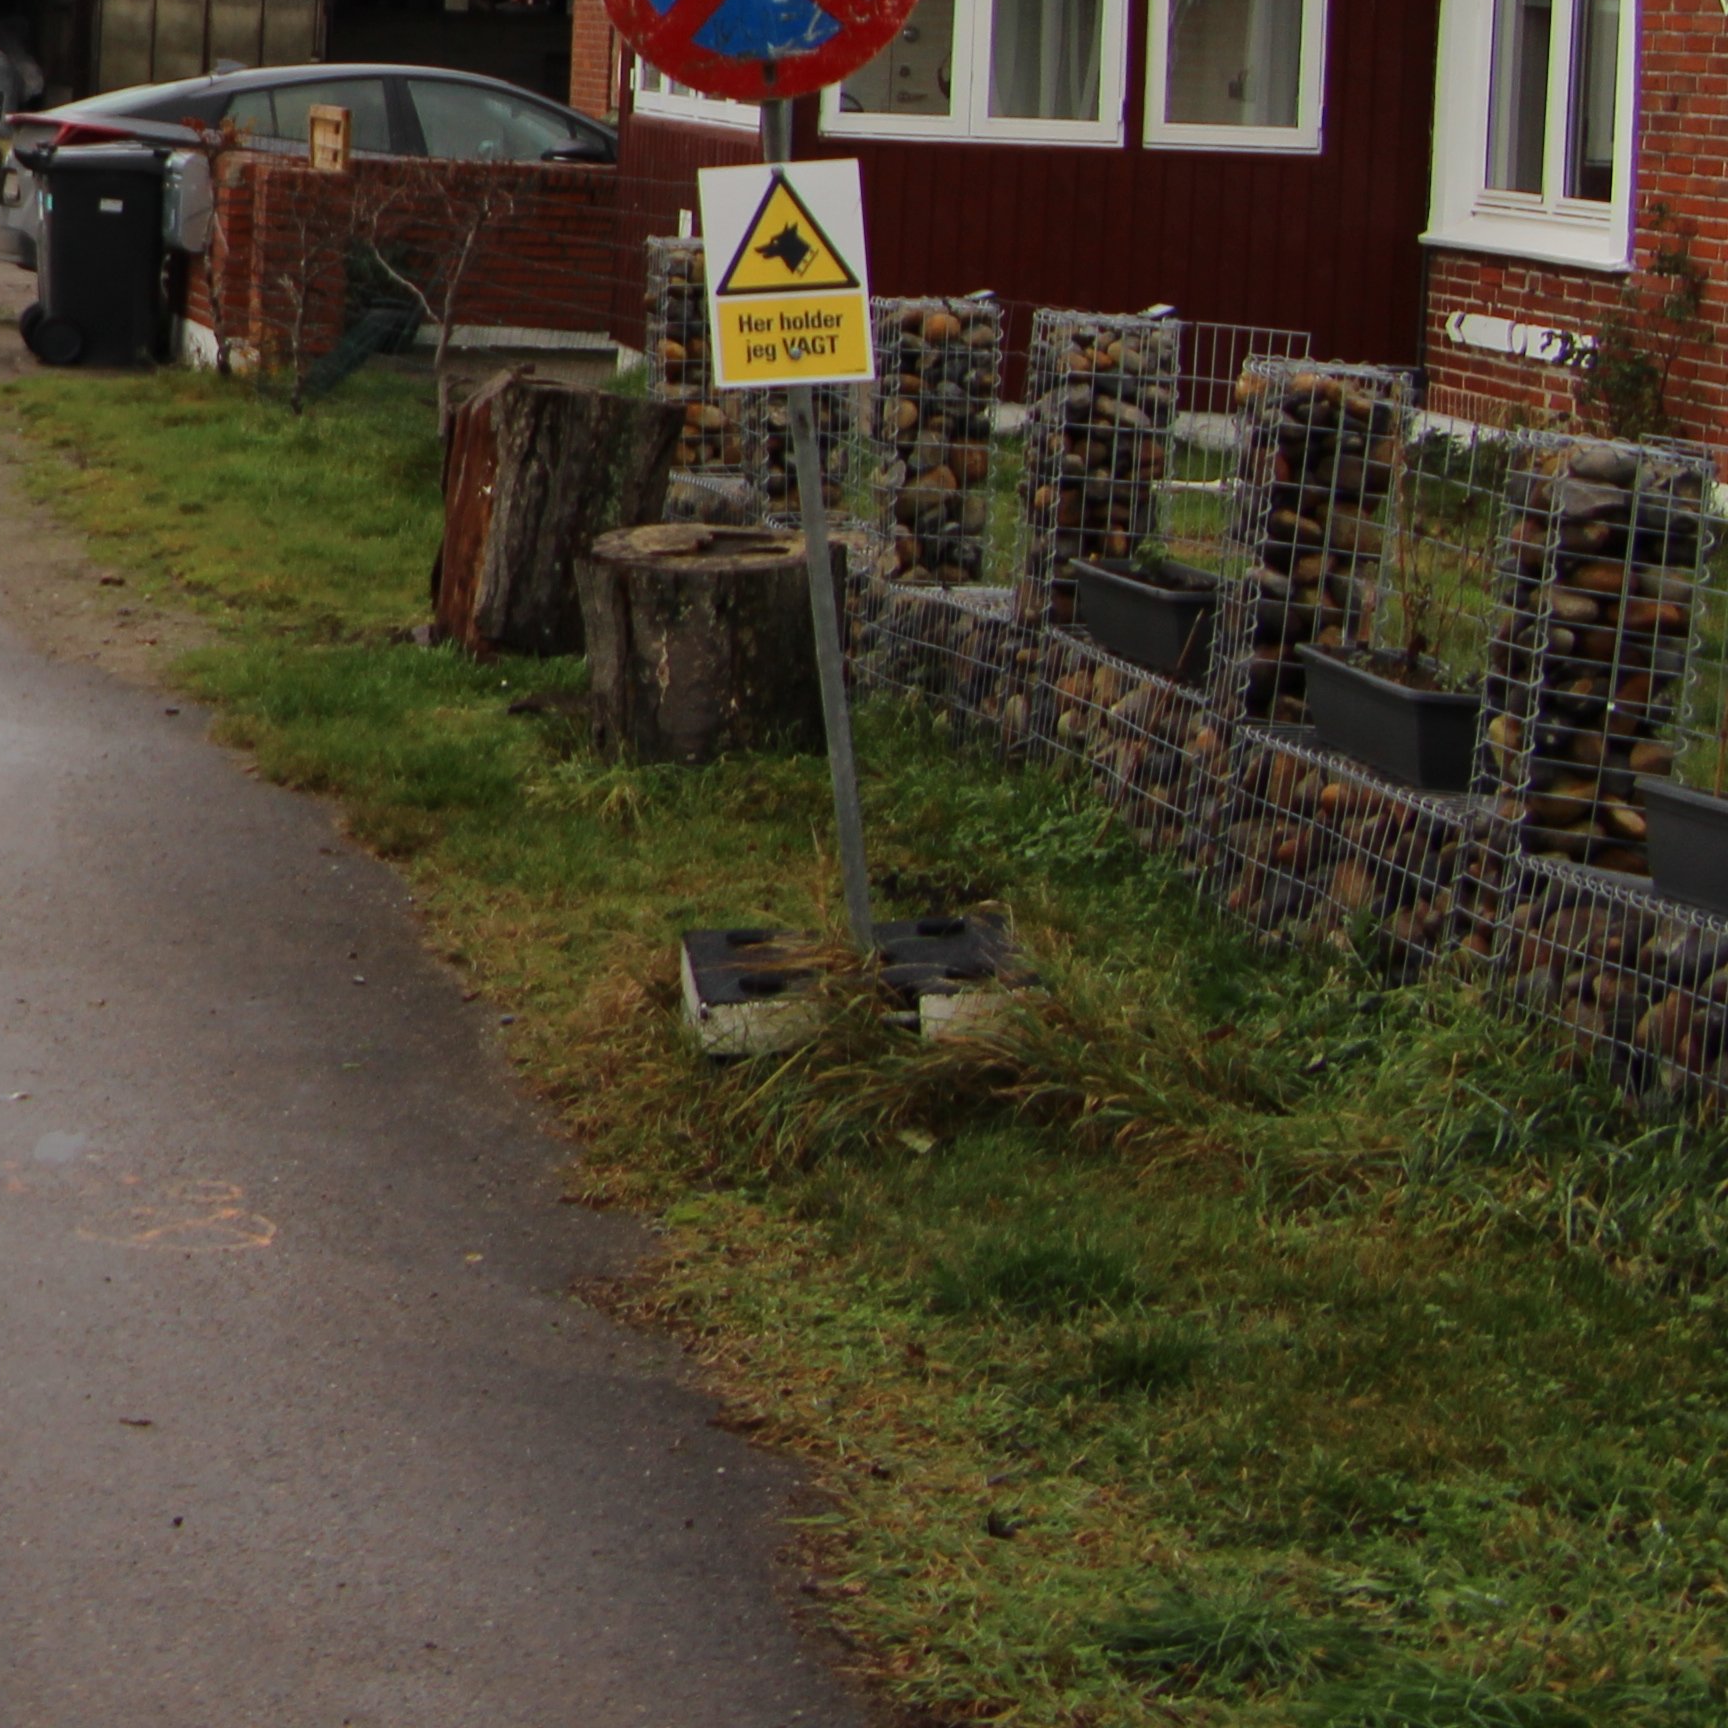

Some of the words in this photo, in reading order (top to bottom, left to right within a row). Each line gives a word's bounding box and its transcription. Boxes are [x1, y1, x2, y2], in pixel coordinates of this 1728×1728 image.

[738, 314, 774, 333] Her
[779, 309, 843, 330] holder
[746, 339, 777, 363] jeg
[782, 334, 839, 356] VAGT
